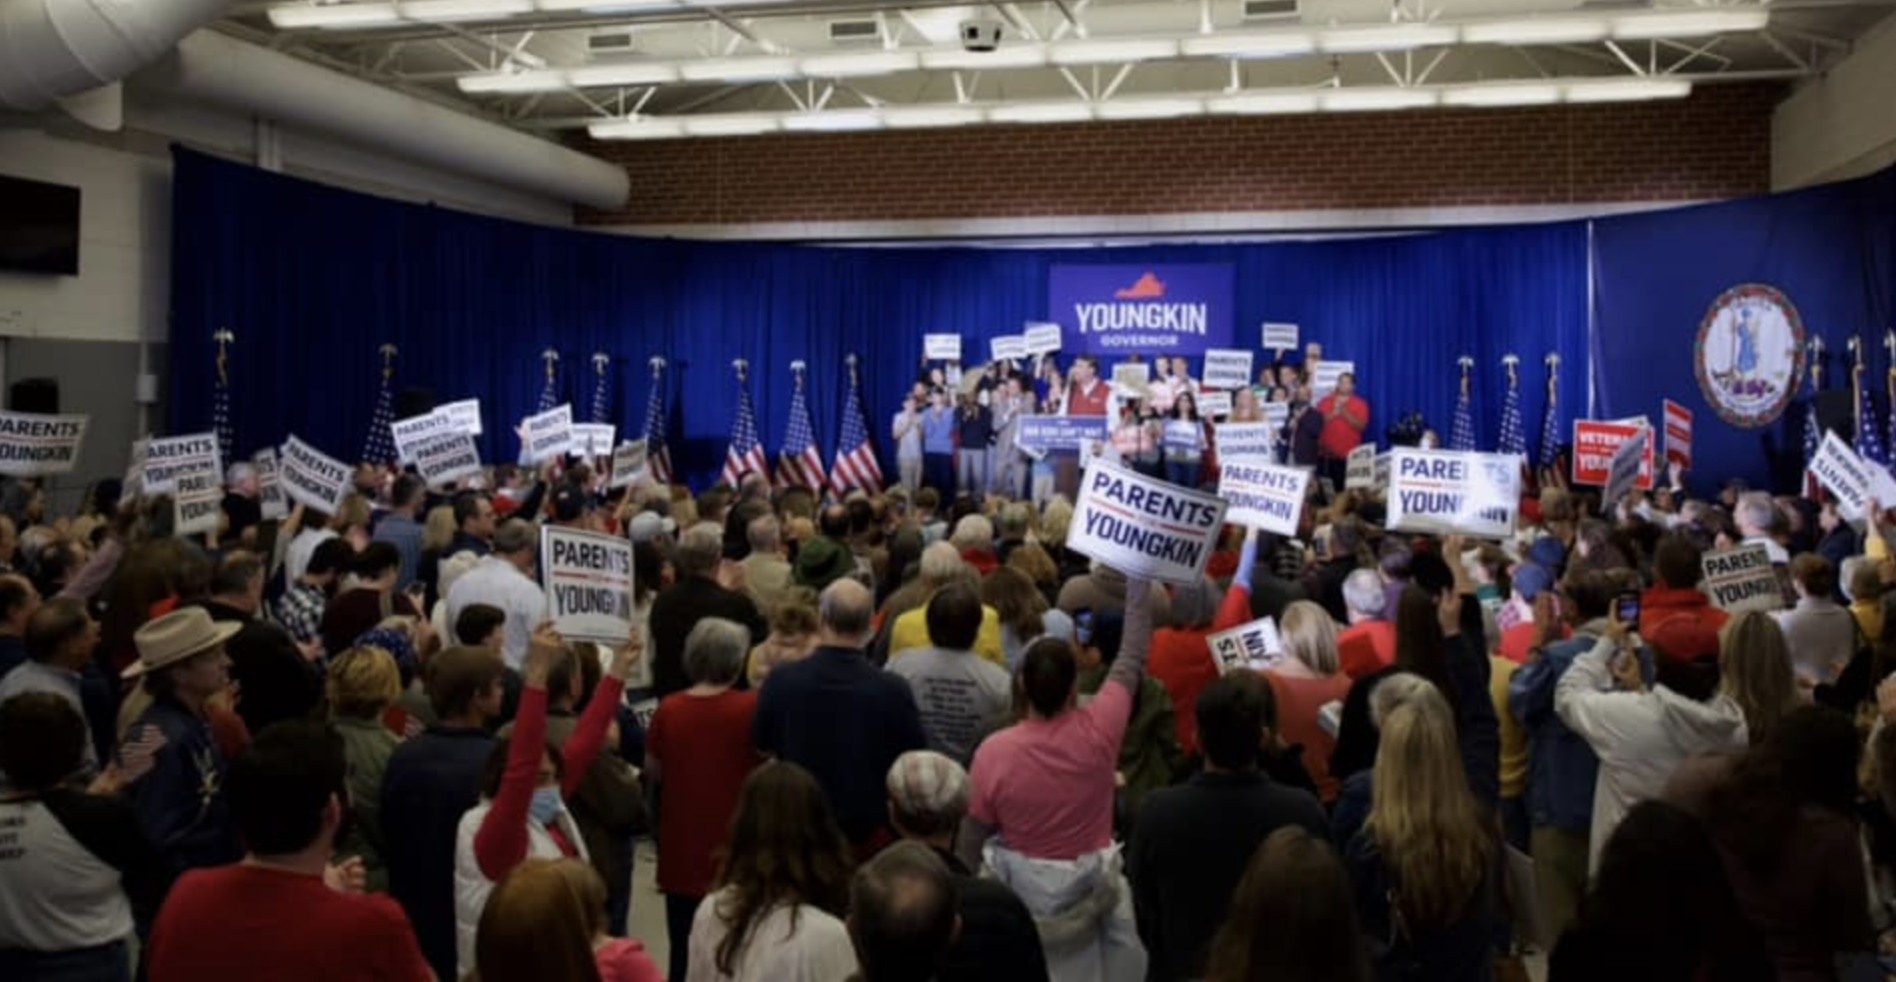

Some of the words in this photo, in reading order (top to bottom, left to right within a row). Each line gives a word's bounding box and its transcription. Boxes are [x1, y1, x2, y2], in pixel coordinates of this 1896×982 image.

[1076, 303, 1207, 335] YOUNGKIN
[1101, 334, 1179, 346] GOVERNOR
[0, 418, 80, 436] ARENTS
[0, 443, 72, 461] OUNGKIN
[418, 436, 470, 460] PARENTS
[288, 442, 345, 482] PARENTS
[1401, 458, 1510, 484] PARETS
[1225, 465, 1298, 491] PARENTS
[1093, 472, 1216, 527] PARENTS
[1086, 507, 1203, 568] YOUNGKIN
